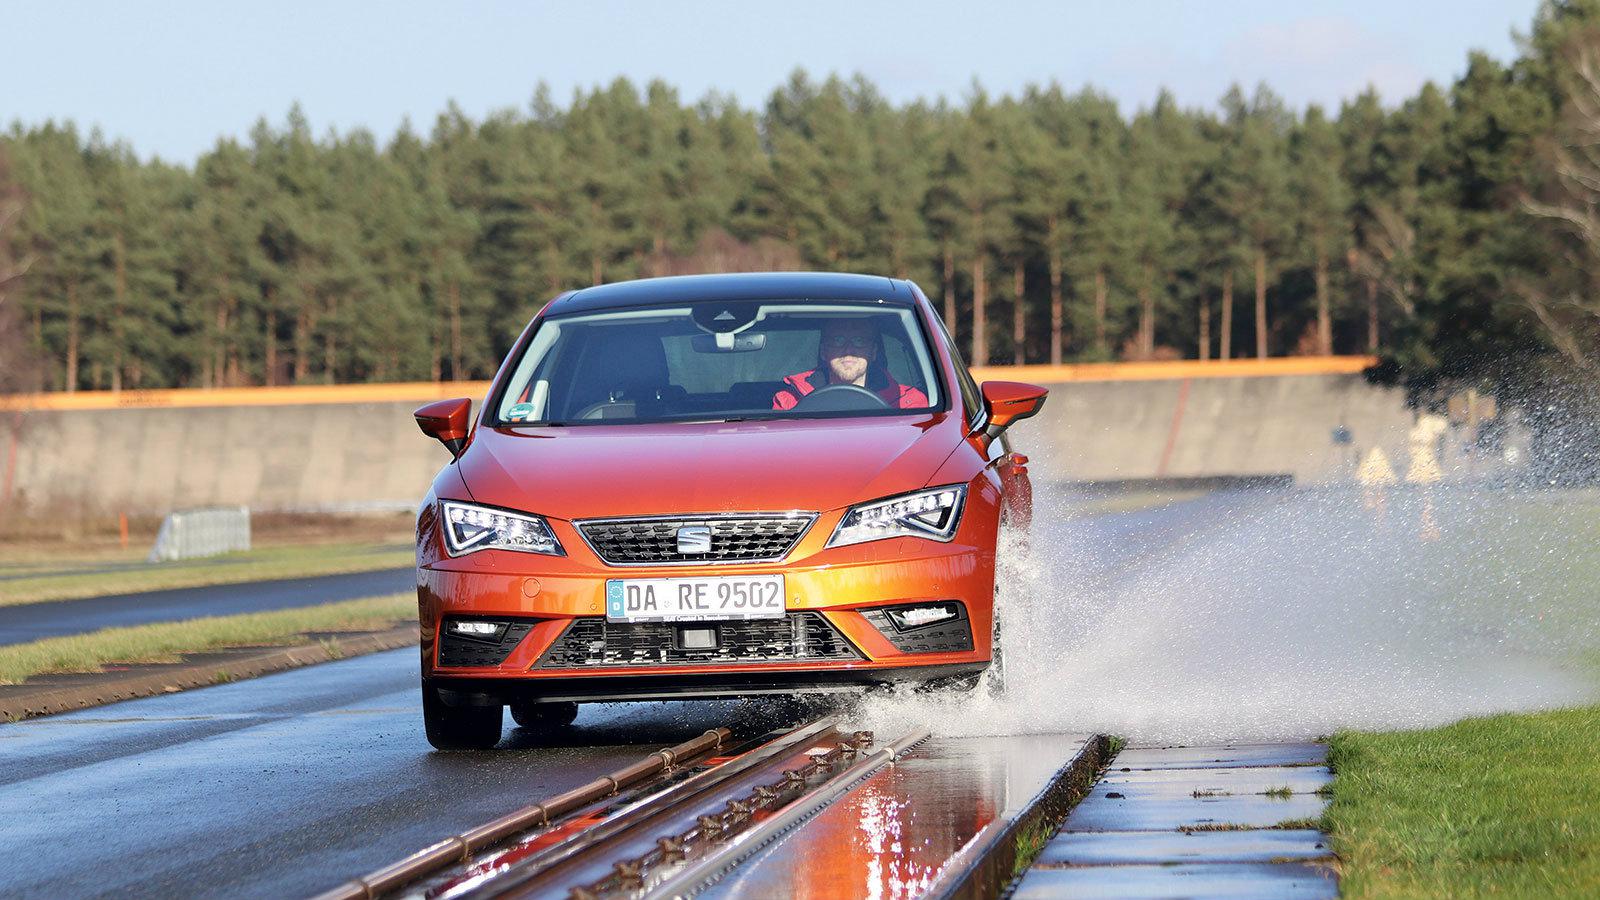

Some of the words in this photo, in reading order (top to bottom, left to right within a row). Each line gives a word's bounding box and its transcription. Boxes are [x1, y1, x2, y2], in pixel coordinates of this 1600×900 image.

[626, 584, 658, 611] DA
[678, 583, 709, 610] RE
[717, 581, 779, 609] 9502
